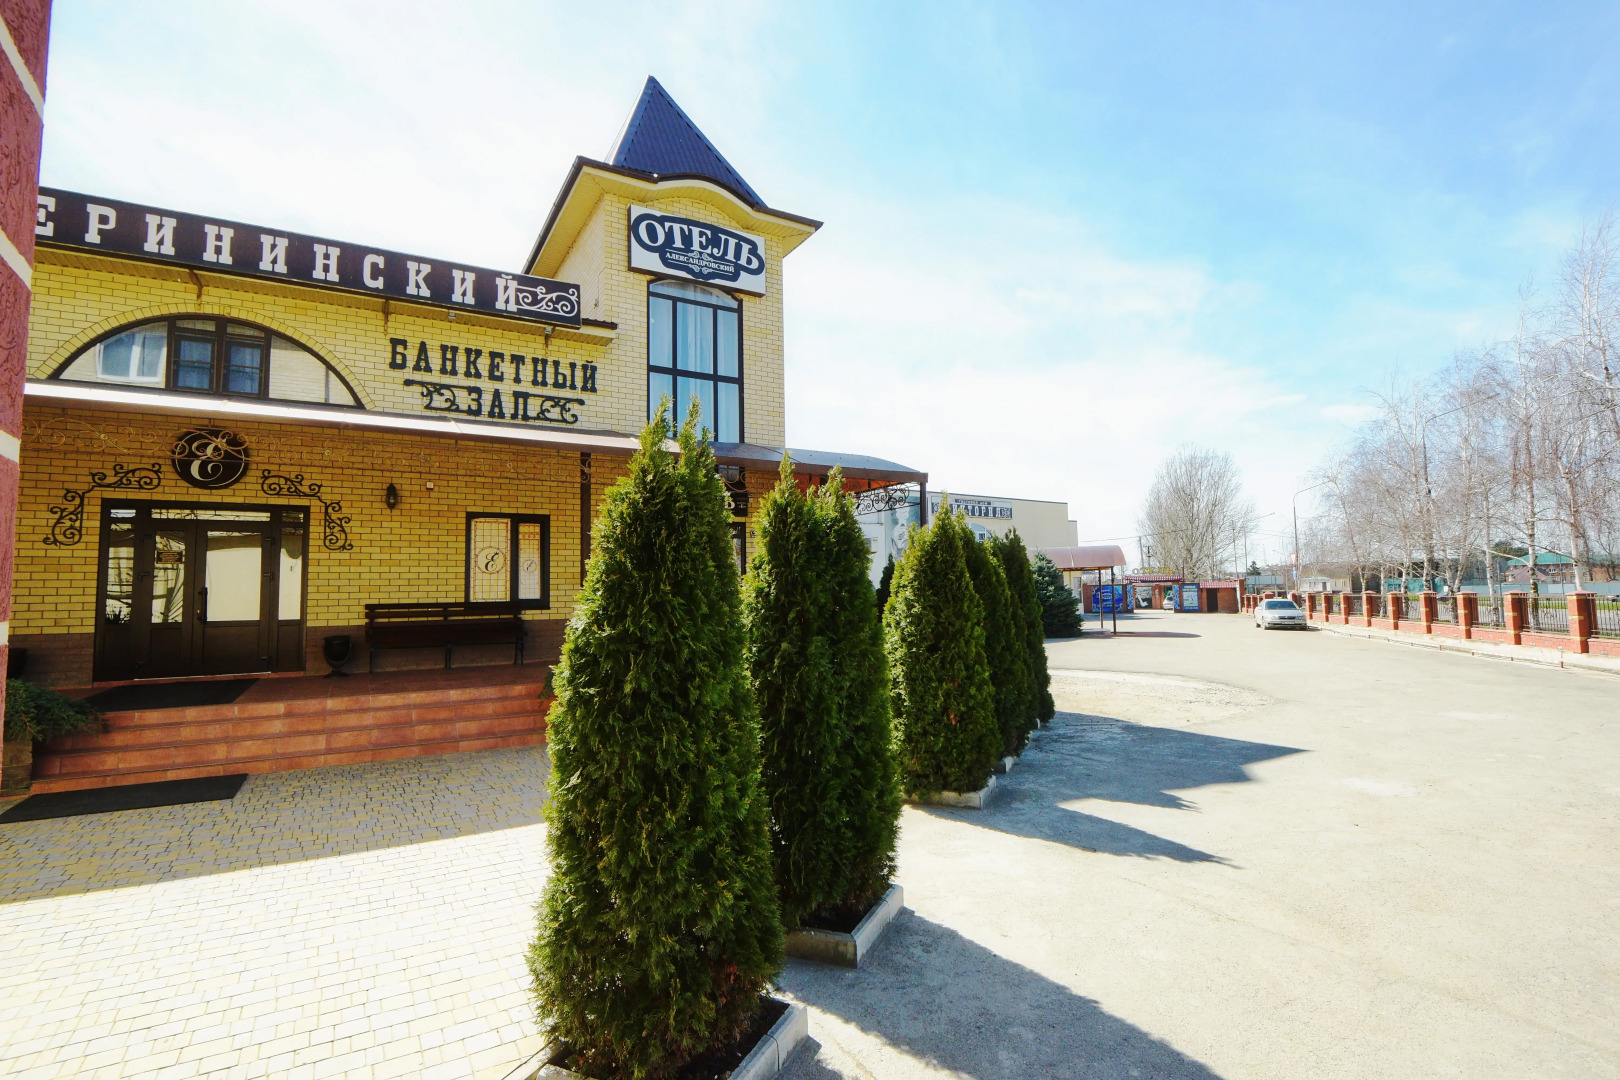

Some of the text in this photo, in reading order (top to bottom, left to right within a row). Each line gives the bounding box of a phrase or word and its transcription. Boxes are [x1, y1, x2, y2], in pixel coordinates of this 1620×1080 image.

[638, 219, 760, 270] ОТЕЛЬ
[665, 252, 735, 273] АЛЕКСАНДРОВСКИЙ
[389, 337, 598, 393] БАНКЕТНЫЙ
[467, 386, 530, 421] ЗАЛ
[951, 503, 1002, 518] ИТОРИЯ
